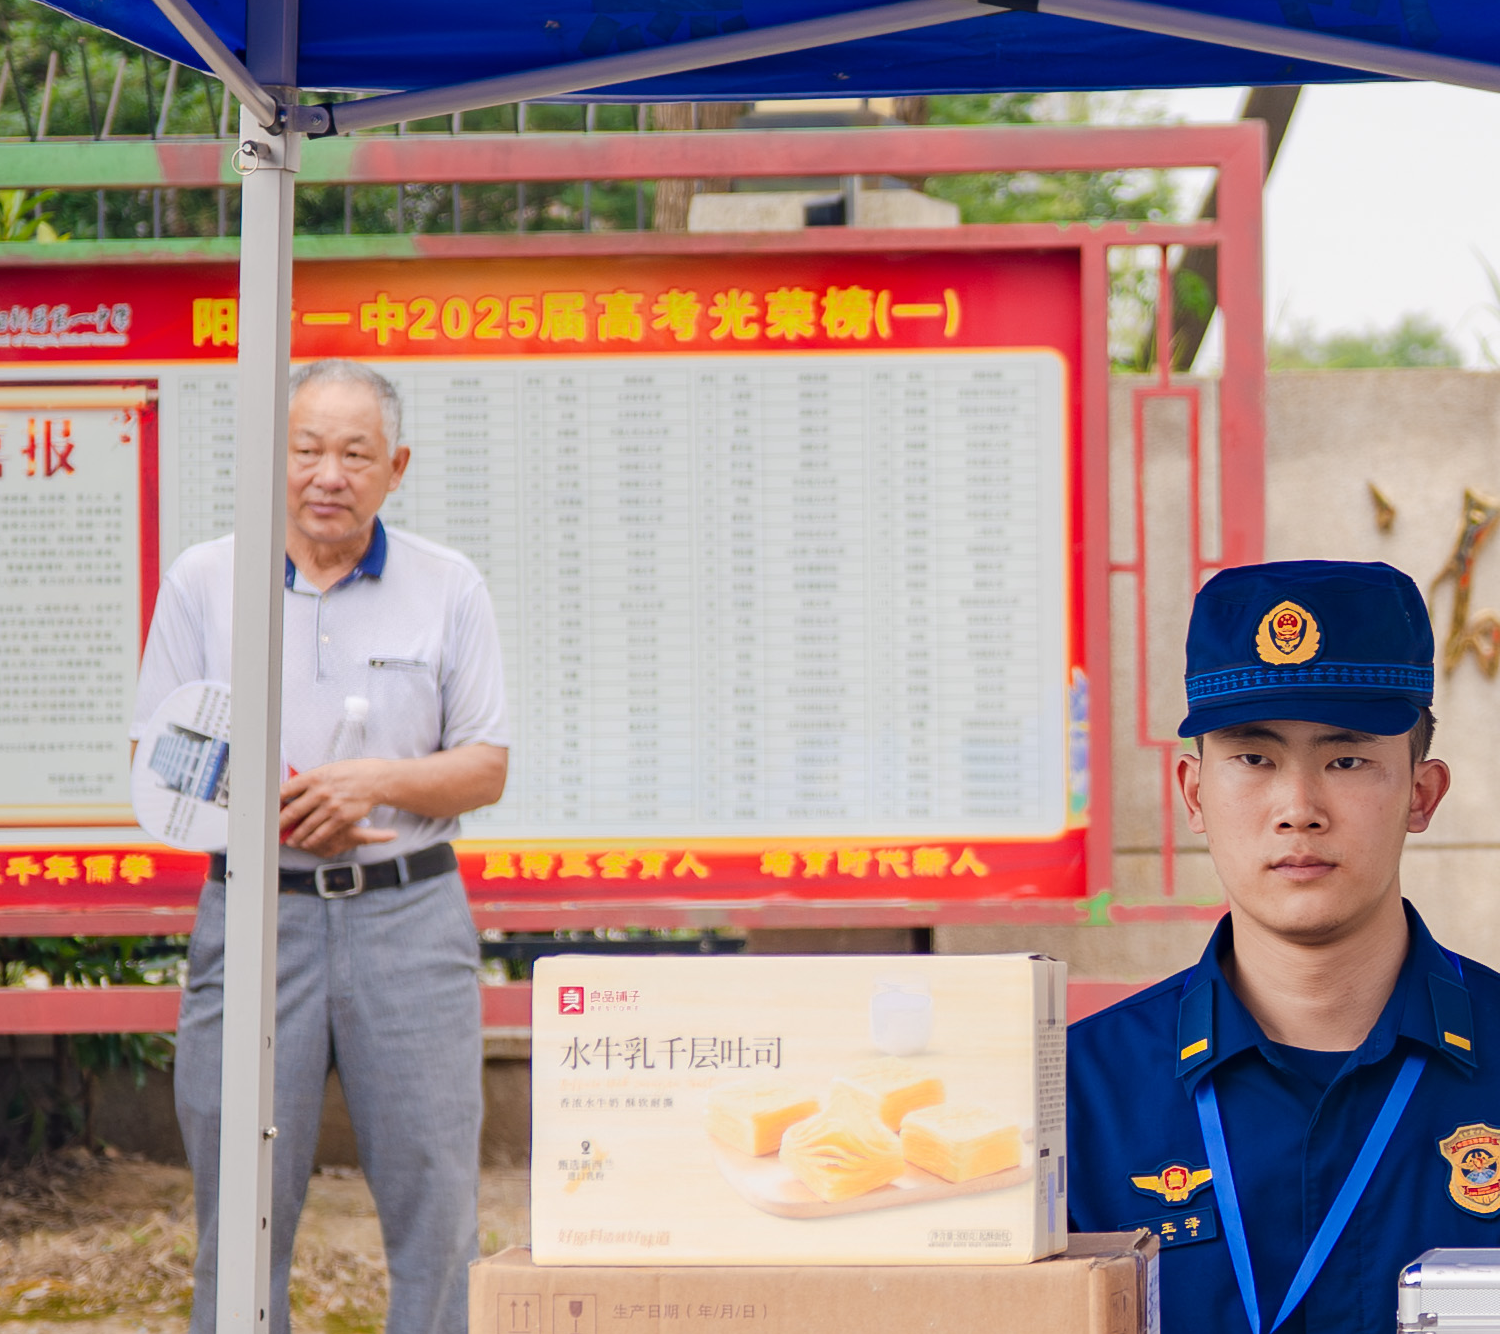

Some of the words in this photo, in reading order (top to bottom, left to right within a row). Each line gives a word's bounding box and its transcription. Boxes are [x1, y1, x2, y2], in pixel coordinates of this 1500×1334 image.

[192, 285, 960, 349] 阳一中2025届高考光荣榜(一)
[760, 847, 989, 879] 培育时代新人
[590, 989, 641, 1004] 良品铺子
[560, 1036, 782, 1071] 水牛乳千层吐司
